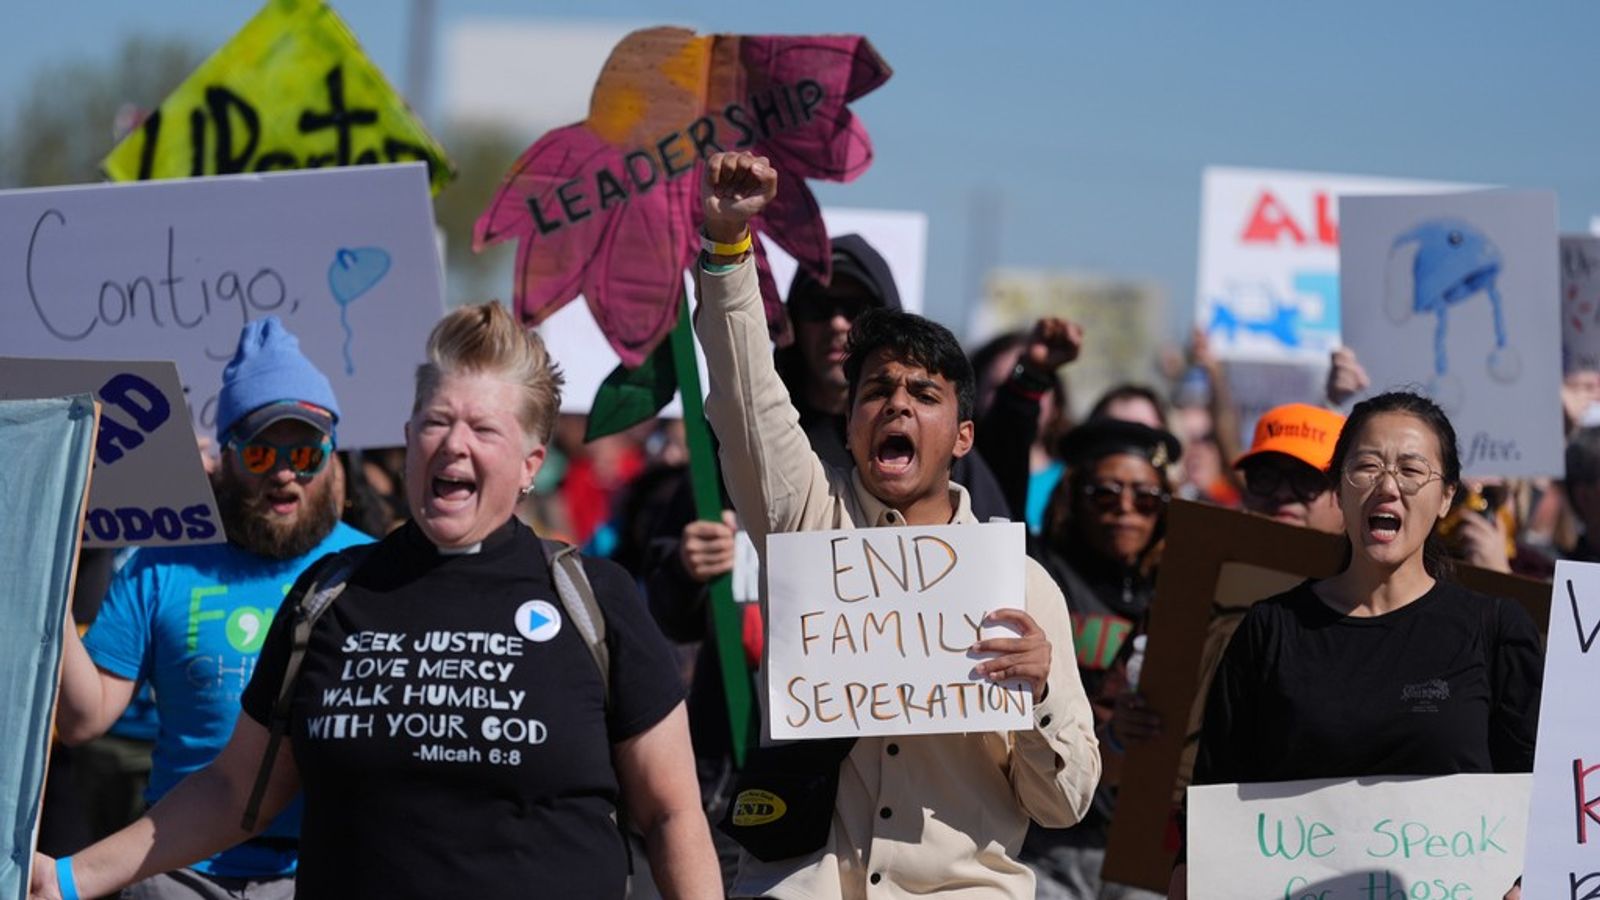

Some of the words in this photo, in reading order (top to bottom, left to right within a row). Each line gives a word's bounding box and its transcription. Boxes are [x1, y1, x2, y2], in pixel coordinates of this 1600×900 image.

[524, 78, 827, 236] LEADERSHIP
[26, 209, 300, 361] Contigo,
[82, 504, 217, 542] ODOS
[830, 534, 958, 603] END
[341, 631, 406, 654] SEEK
[413, 631, 523, 656] JUSTICE
[800, 609, 988, 658] FAMILY
[341, 658, 409, 681] LOVE
[417, 658, 515, 683] MERCY
[322, 684, 393, 707] WALK
[403, 684, 526, 711] HUMBLY
[786, 676, 1026, 730] SEPERATION
[307, 714, 374, 739] WITH
[386, 713, 468, 739] YOUR
[481, 718, 548, 744] GOD
[412, 745, 481, 763] -Micah
[488, 749, 521, 766] 6:8
[1257, 812, 1336, 861] We
